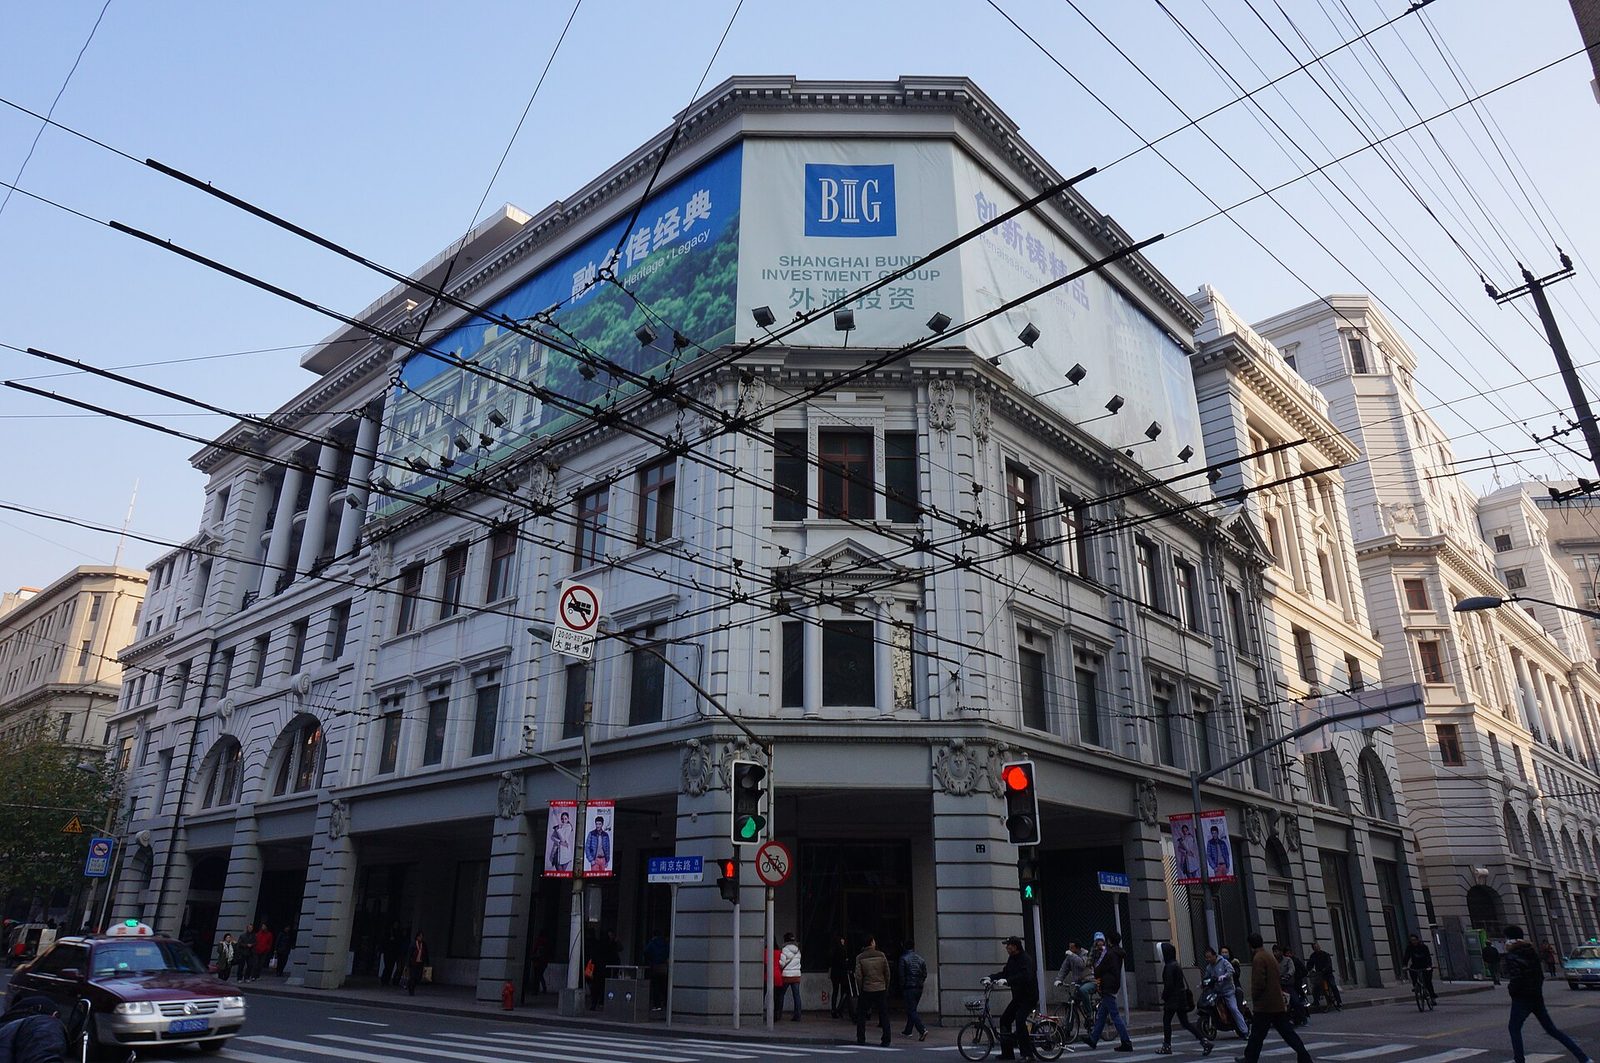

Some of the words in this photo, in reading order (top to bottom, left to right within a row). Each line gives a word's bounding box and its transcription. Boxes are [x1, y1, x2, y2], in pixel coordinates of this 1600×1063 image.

[818, 178, 882, 223] BIG
[623, 257, 665, 288] Heritage
[671, 229, 711, 259] Legacy
[779, 255, 869, 268] SHANGHAI
[762, 269, 873, 282] INVESTMENT
[878, 269, 941, 282] GOUP
[660, 860, 691, 871] 南京东路
